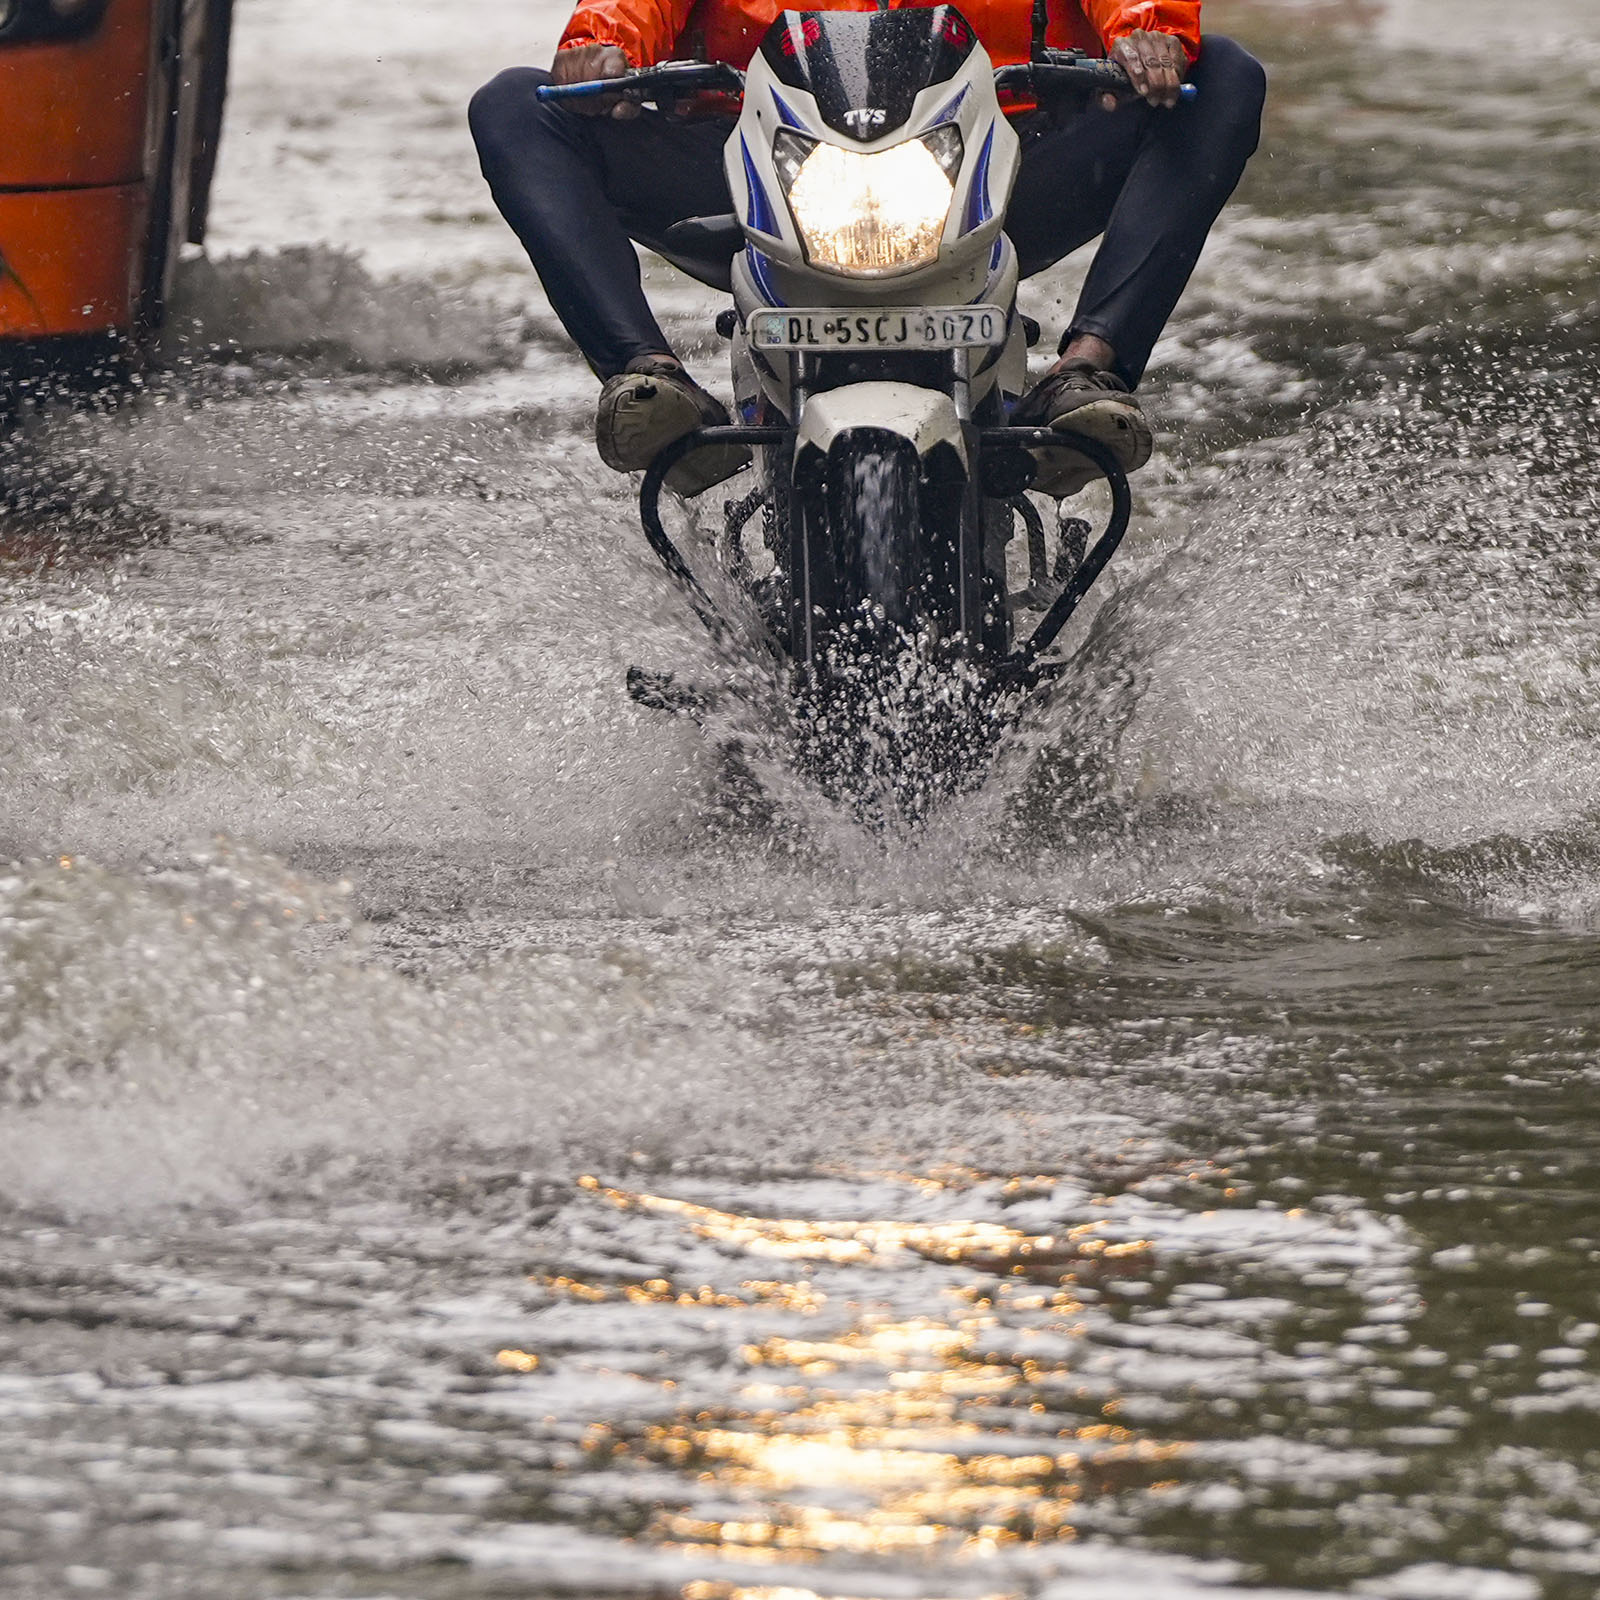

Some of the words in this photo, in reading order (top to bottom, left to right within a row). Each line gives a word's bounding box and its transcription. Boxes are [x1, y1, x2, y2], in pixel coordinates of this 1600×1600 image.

[843, 108, 886, 126] TVS
[788, 317, 819, 344] DL
[836, 316, 908, 344] 5SCJ
[766, 336, 782, 344] IND
